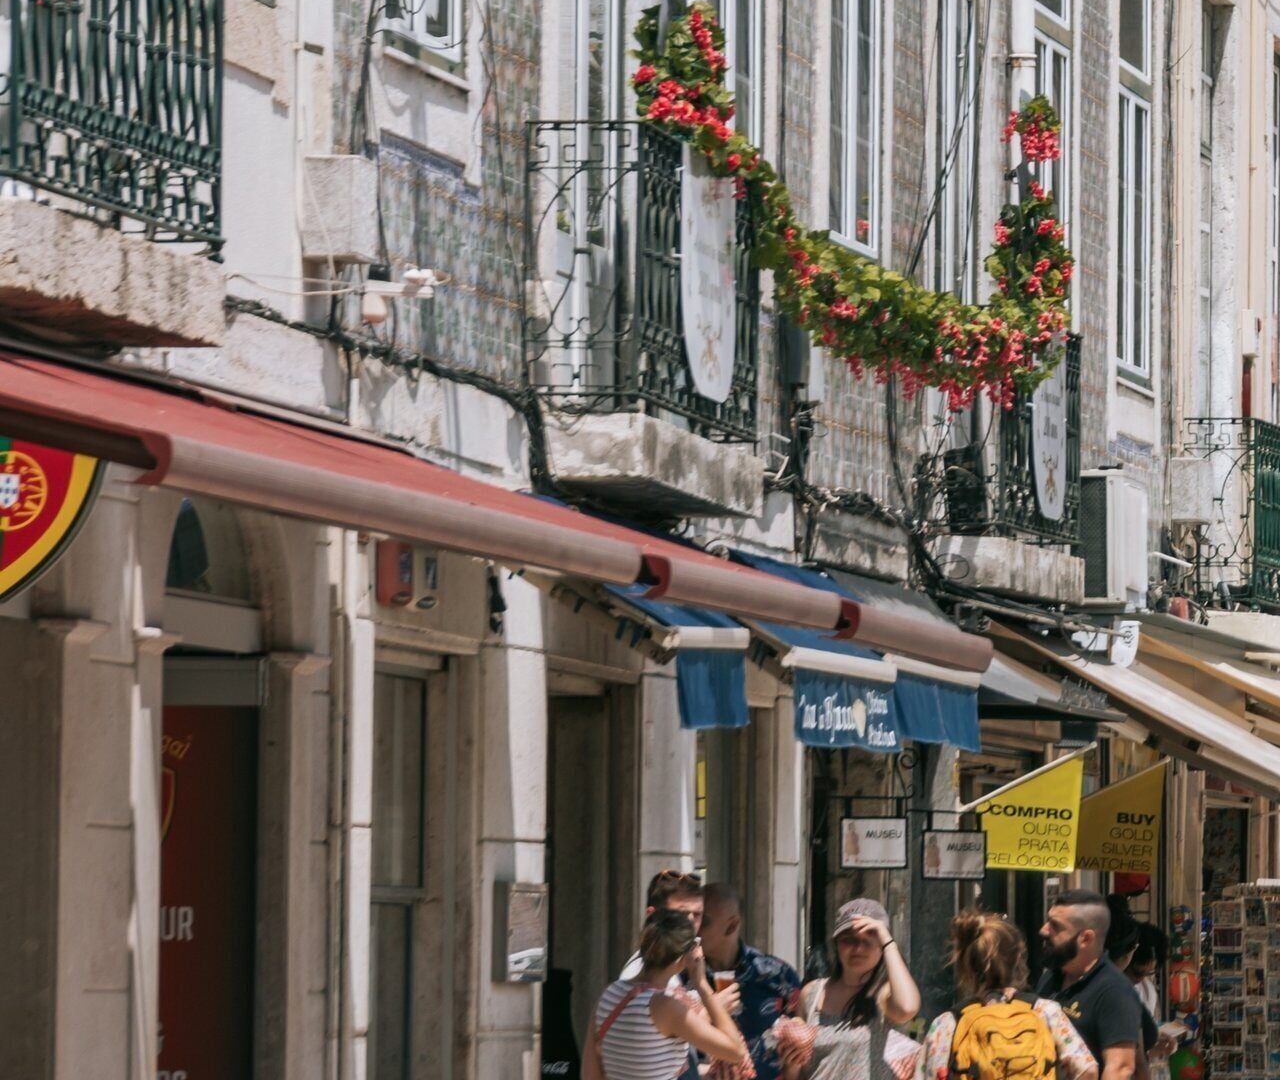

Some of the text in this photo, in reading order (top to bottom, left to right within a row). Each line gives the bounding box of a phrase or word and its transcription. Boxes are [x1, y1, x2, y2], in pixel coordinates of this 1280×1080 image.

[988, 803, 1073, 821] COMPRO
[1116, 811, 1156, 825] BUY
[865, 829, 902, 839] MUSEU
[1022, 821, 1072, 837] OURO
[1109, 826, 1154, 842] GOLD
[946, 842, 982, 852] MUSEU
[1018, 838, 1070, 853] PRATA
[1101, 841, 1153, 857] SILVER
[986, 852, 1069, 869] RELÓGIOS
[1076, 856, 1151, 871] WATCHES
